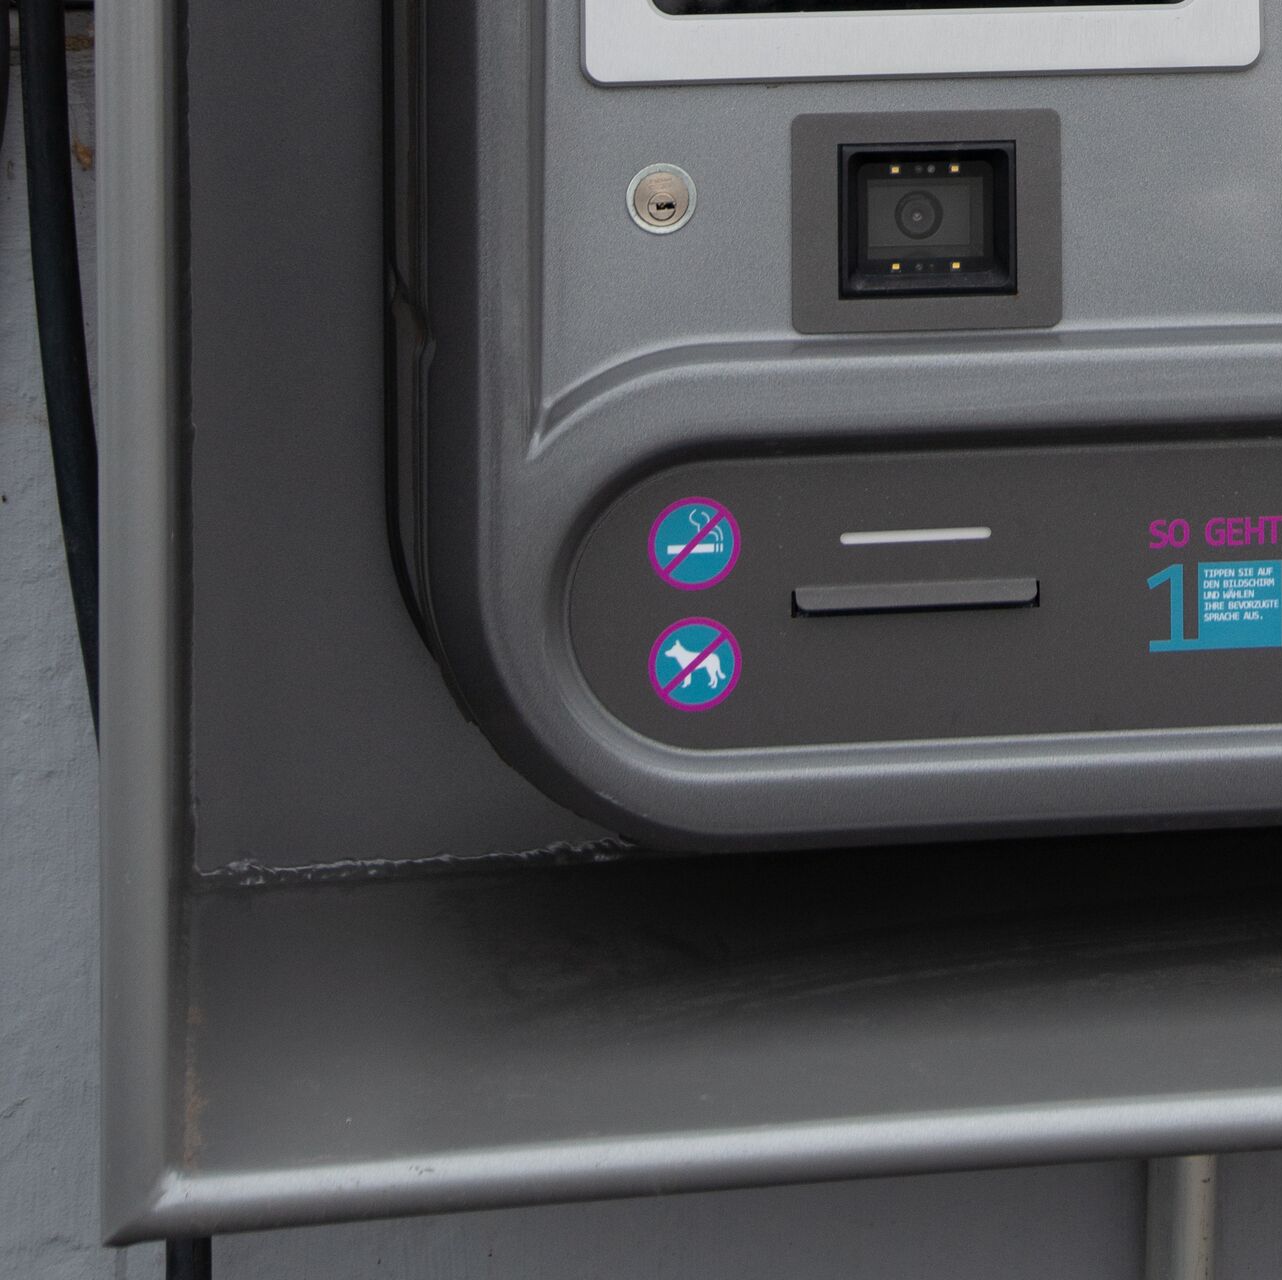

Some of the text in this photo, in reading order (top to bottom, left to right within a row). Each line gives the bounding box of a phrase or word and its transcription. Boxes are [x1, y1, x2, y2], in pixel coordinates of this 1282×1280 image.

[1149, 518, 1191, 549] SO
[1203, 567, 1273, 578] TIPPEN SIE AUF
[1203, 578, 1275, 589] DEN BILDSCHIRM
[1203, 589, 1255, 600] UND WÄHLEN
[1147, 563, 1198, 652] 1
[1203, 599, 1279, 611] IHRE BEVORZUGTE
[1203, 611, 1264, 622] SPRACHE AUS.
